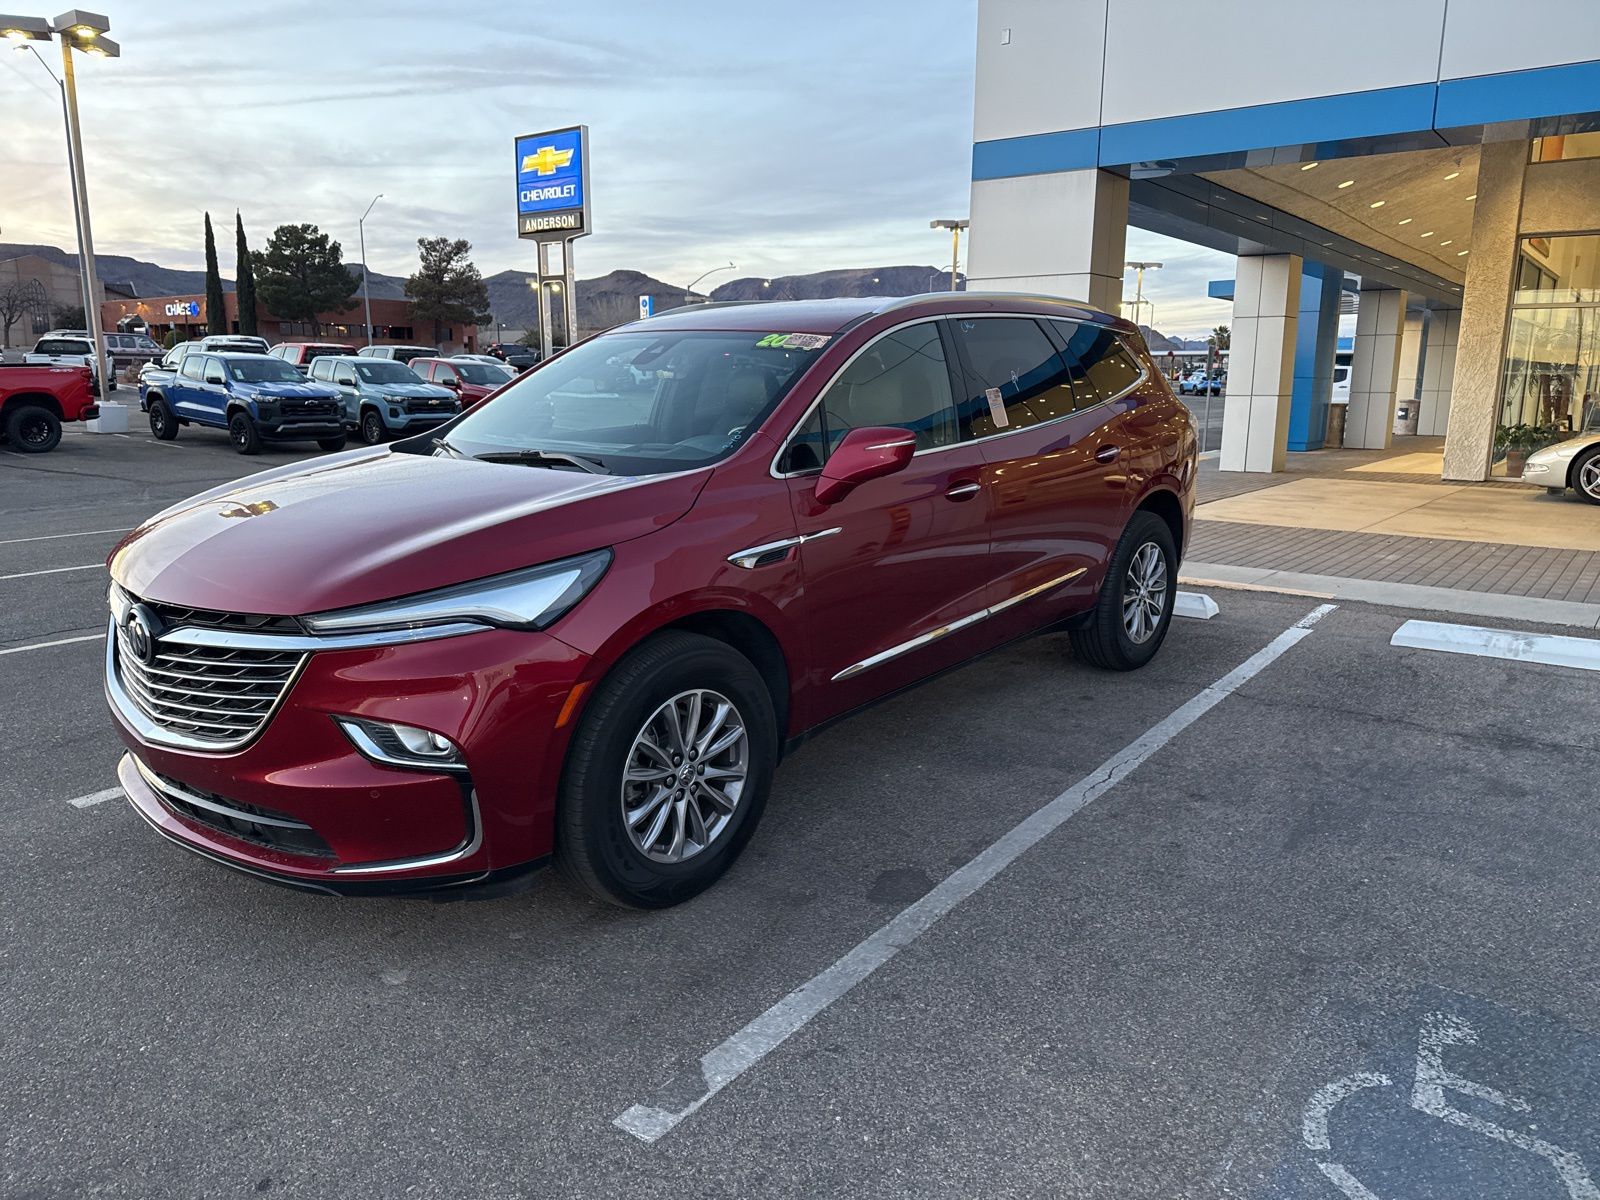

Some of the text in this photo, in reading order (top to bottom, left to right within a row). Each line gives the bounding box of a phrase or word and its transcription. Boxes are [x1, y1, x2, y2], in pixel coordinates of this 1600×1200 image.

[521, 185, 575, 202] CHEVROLET
[525, 216, 575, 230] ANDERSON
[166, 303, 191, 316] CHASE
